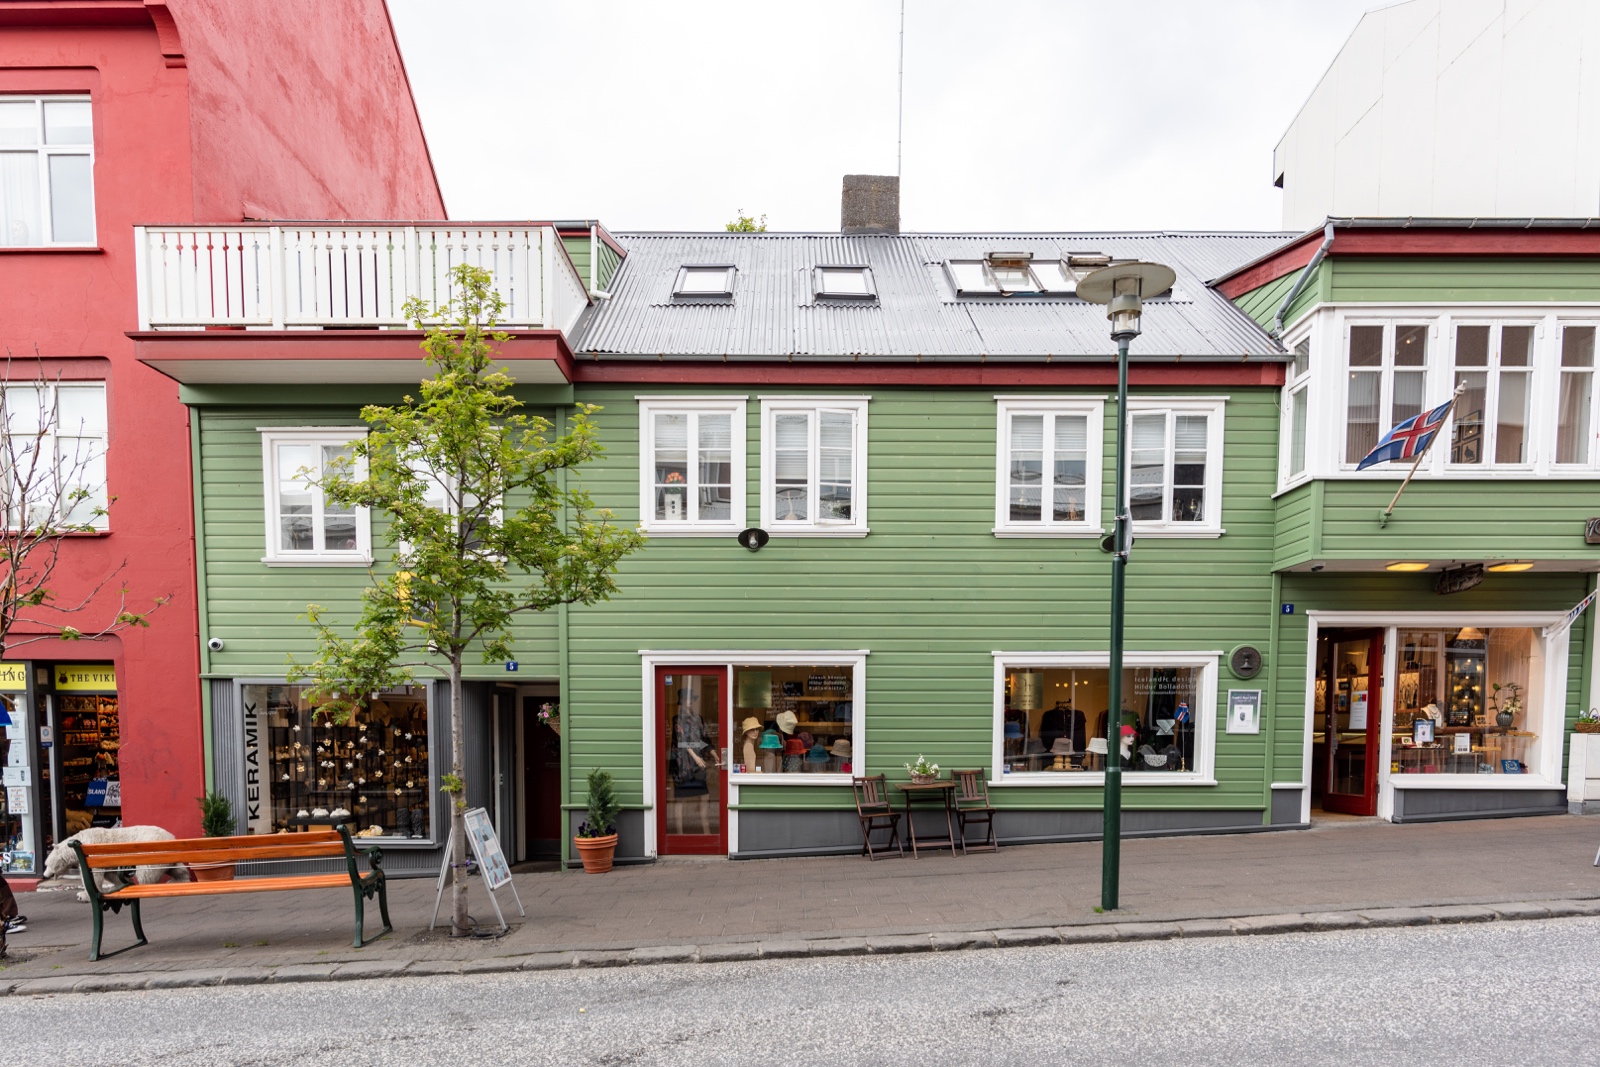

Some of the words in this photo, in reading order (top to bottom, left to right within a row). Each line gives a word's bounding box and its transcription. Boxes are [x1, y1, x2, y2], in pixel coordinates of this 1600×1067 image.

[1286, 604, 1290, 613] 5
[509, 662, 514, 671] 5
[70, 674, 90, 682] THE
[93, 674, 115, 682] VIKI
[245, 702, 260, 820] KERAMIK
